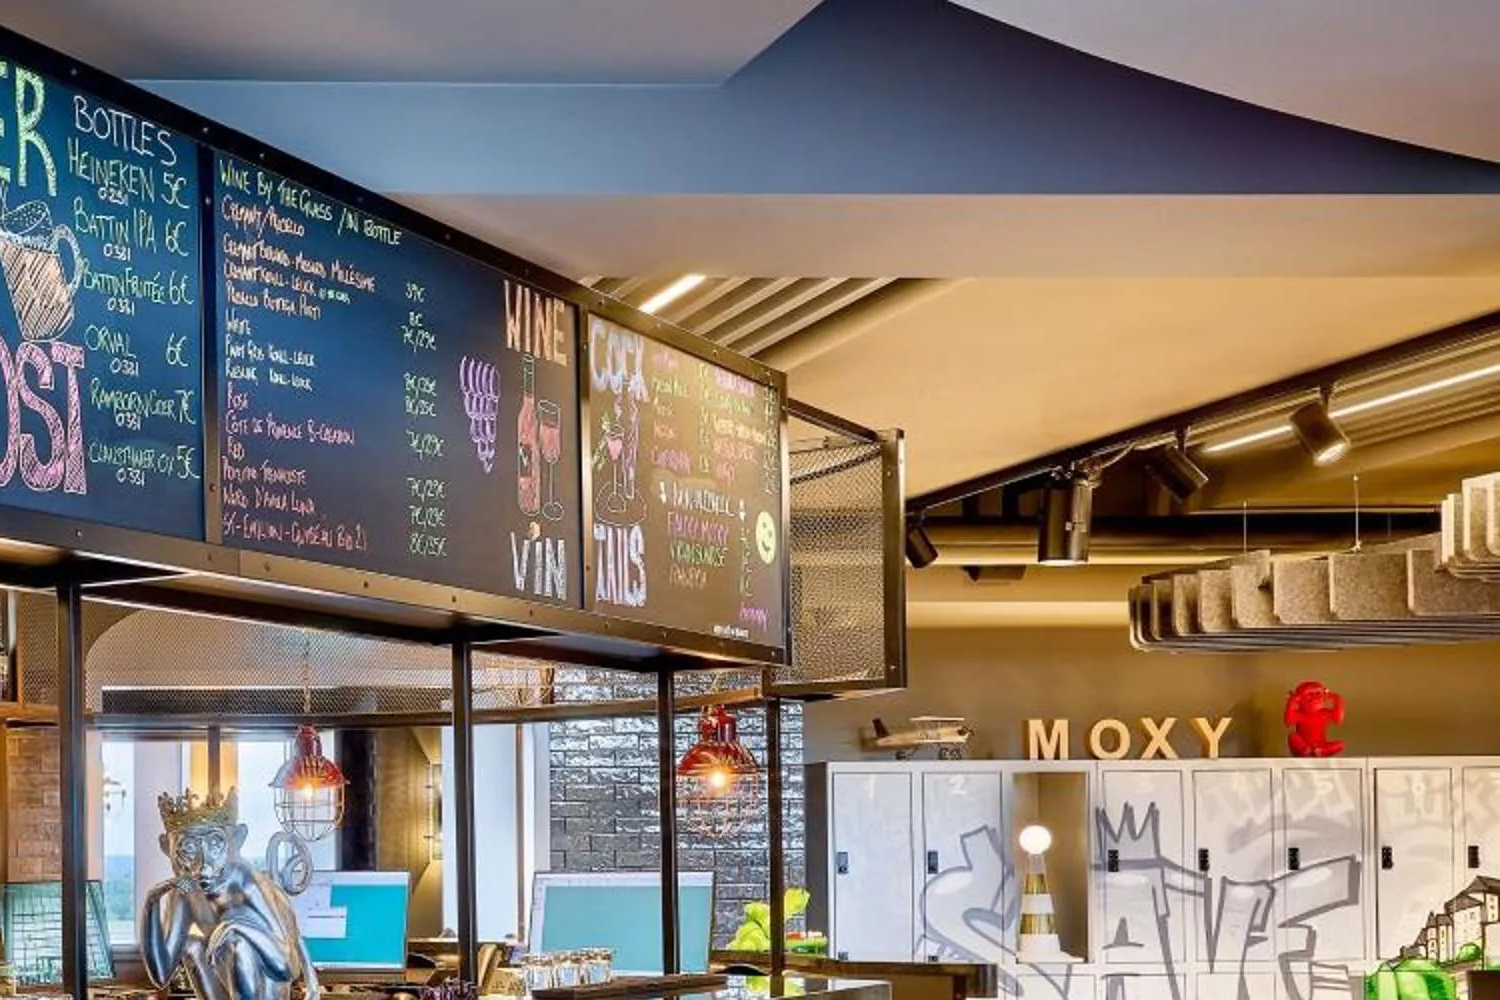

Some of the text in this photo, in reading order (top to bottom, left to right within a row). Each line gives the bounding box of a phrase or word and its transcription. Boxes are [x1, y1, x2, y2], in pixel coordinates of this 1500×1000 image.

[73, 95, 178, 167] BOTTLES
[67, 136, 190, 209] HEINEKEN 5€
[219, 159, 251, 195] WINE
[257, 171, 273, 205] BY
[277, 178, 298, 209] THE
[300, 189, 333, 221] GLASS
[364, 219, 403, 246] BOTTLE
[73, 196, 190, 257] BATTIN IPA 6€
[83, 258, 125, 297] BATTIN
[84, 324, 137, 359] ORVAL
[503, 279, 567, 367] WINE
[510, 531, 566, 601] VIN
[1027, 717, 1233, 760] MOXY
